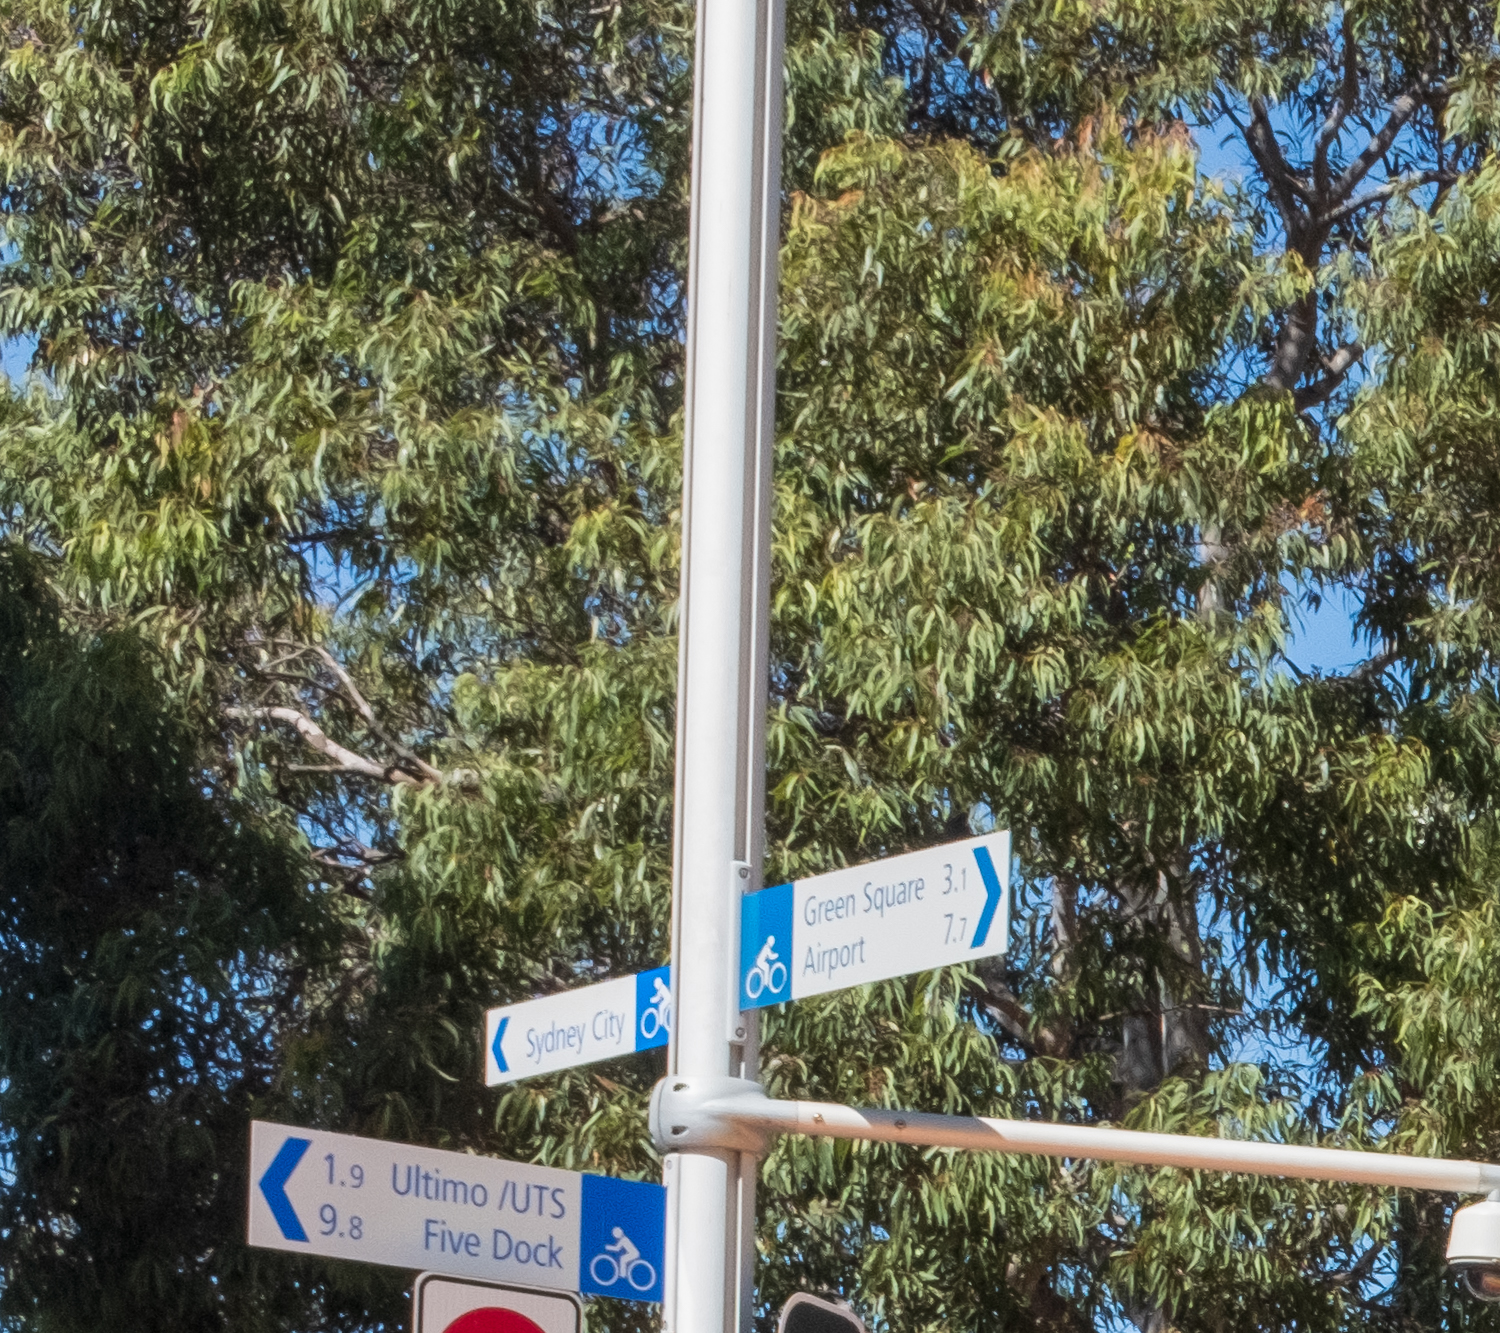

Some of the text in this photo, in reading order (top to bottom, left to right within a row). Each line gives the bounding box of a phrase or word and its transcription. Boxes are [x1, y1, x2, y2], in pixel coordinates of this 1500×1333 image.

[803, 863, 968, 927] Green Square 3.1
[801, 914, 969, 978] Airport 7.7
[525, 1007, 627, 1060] Sydney City
[324, 1153, 567, 1221] 1.9 Ultimo /UTS
[319, 1207, 565, 1270] 9.8 Five Dock
